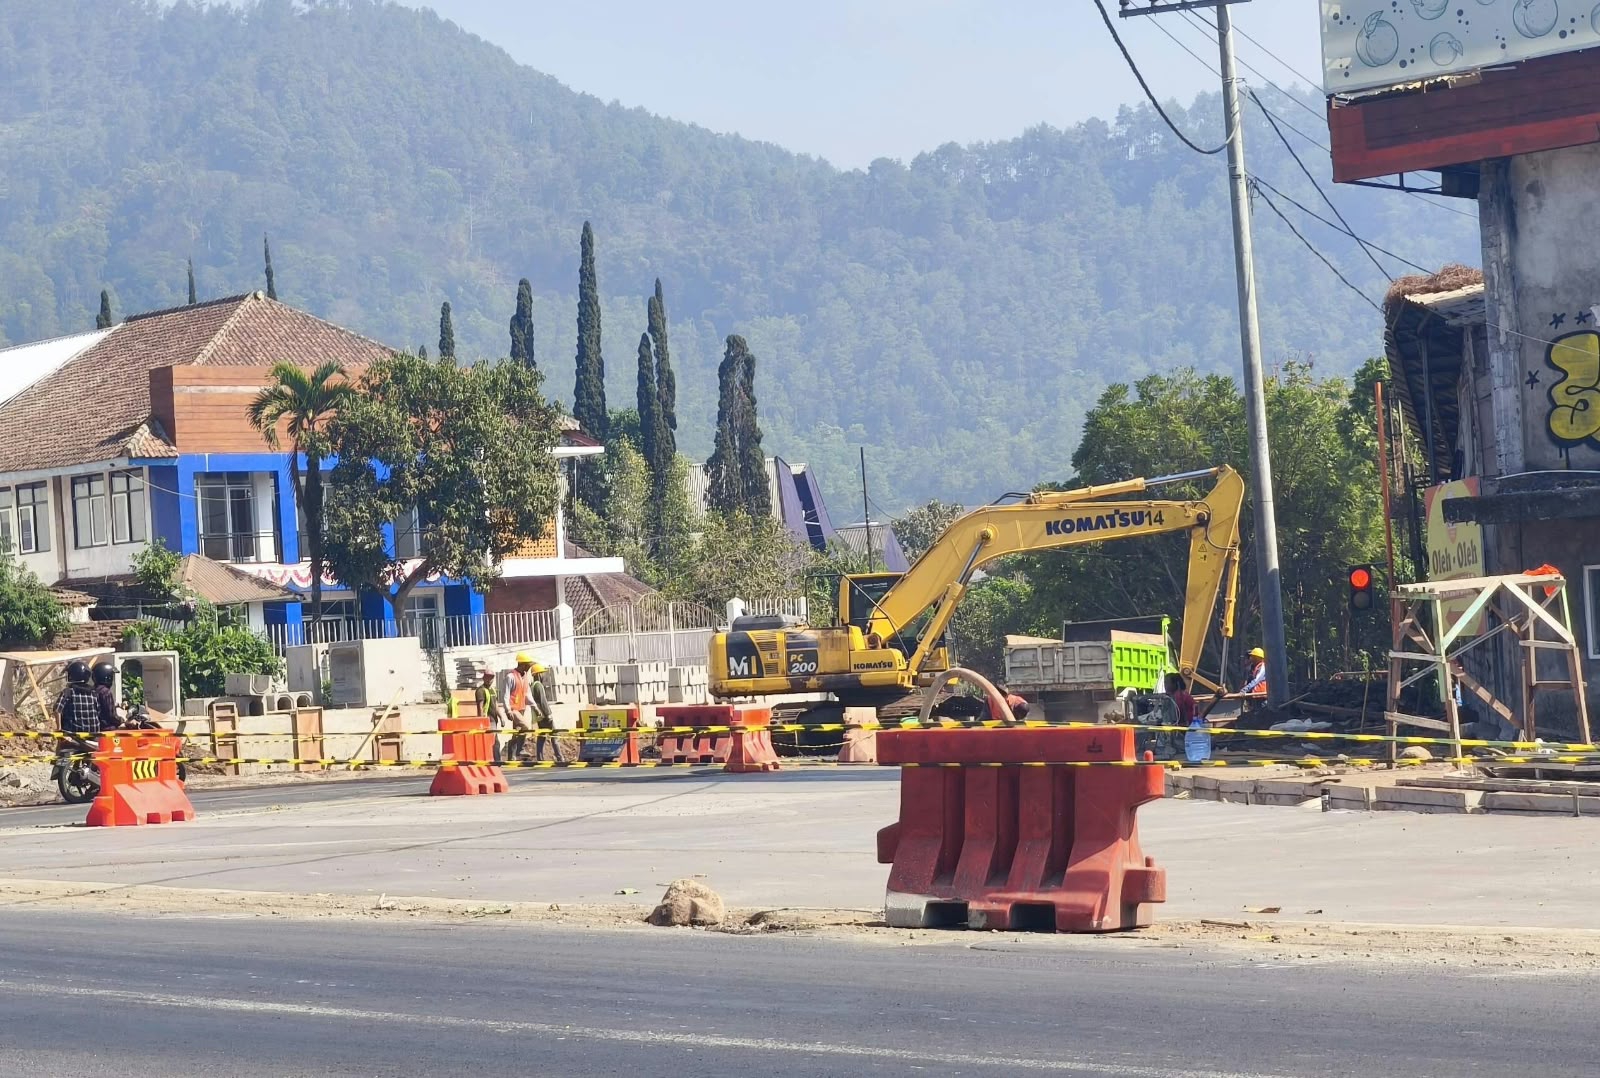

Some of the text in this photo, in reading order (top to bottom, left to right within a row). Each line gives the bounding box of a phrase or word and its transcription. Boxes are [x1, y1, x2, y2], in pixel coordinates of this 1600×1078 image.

[1046, 509, 1164, 535] KOMATSU 14
[1432, 547, 1452, 575] Oleh
[1456, 540, 1478, 569] Oleh
[790, 654, 804, 663] PC
[790, 662, 816, 674] 200
[853, 660, 893, 670] KOMATSU
